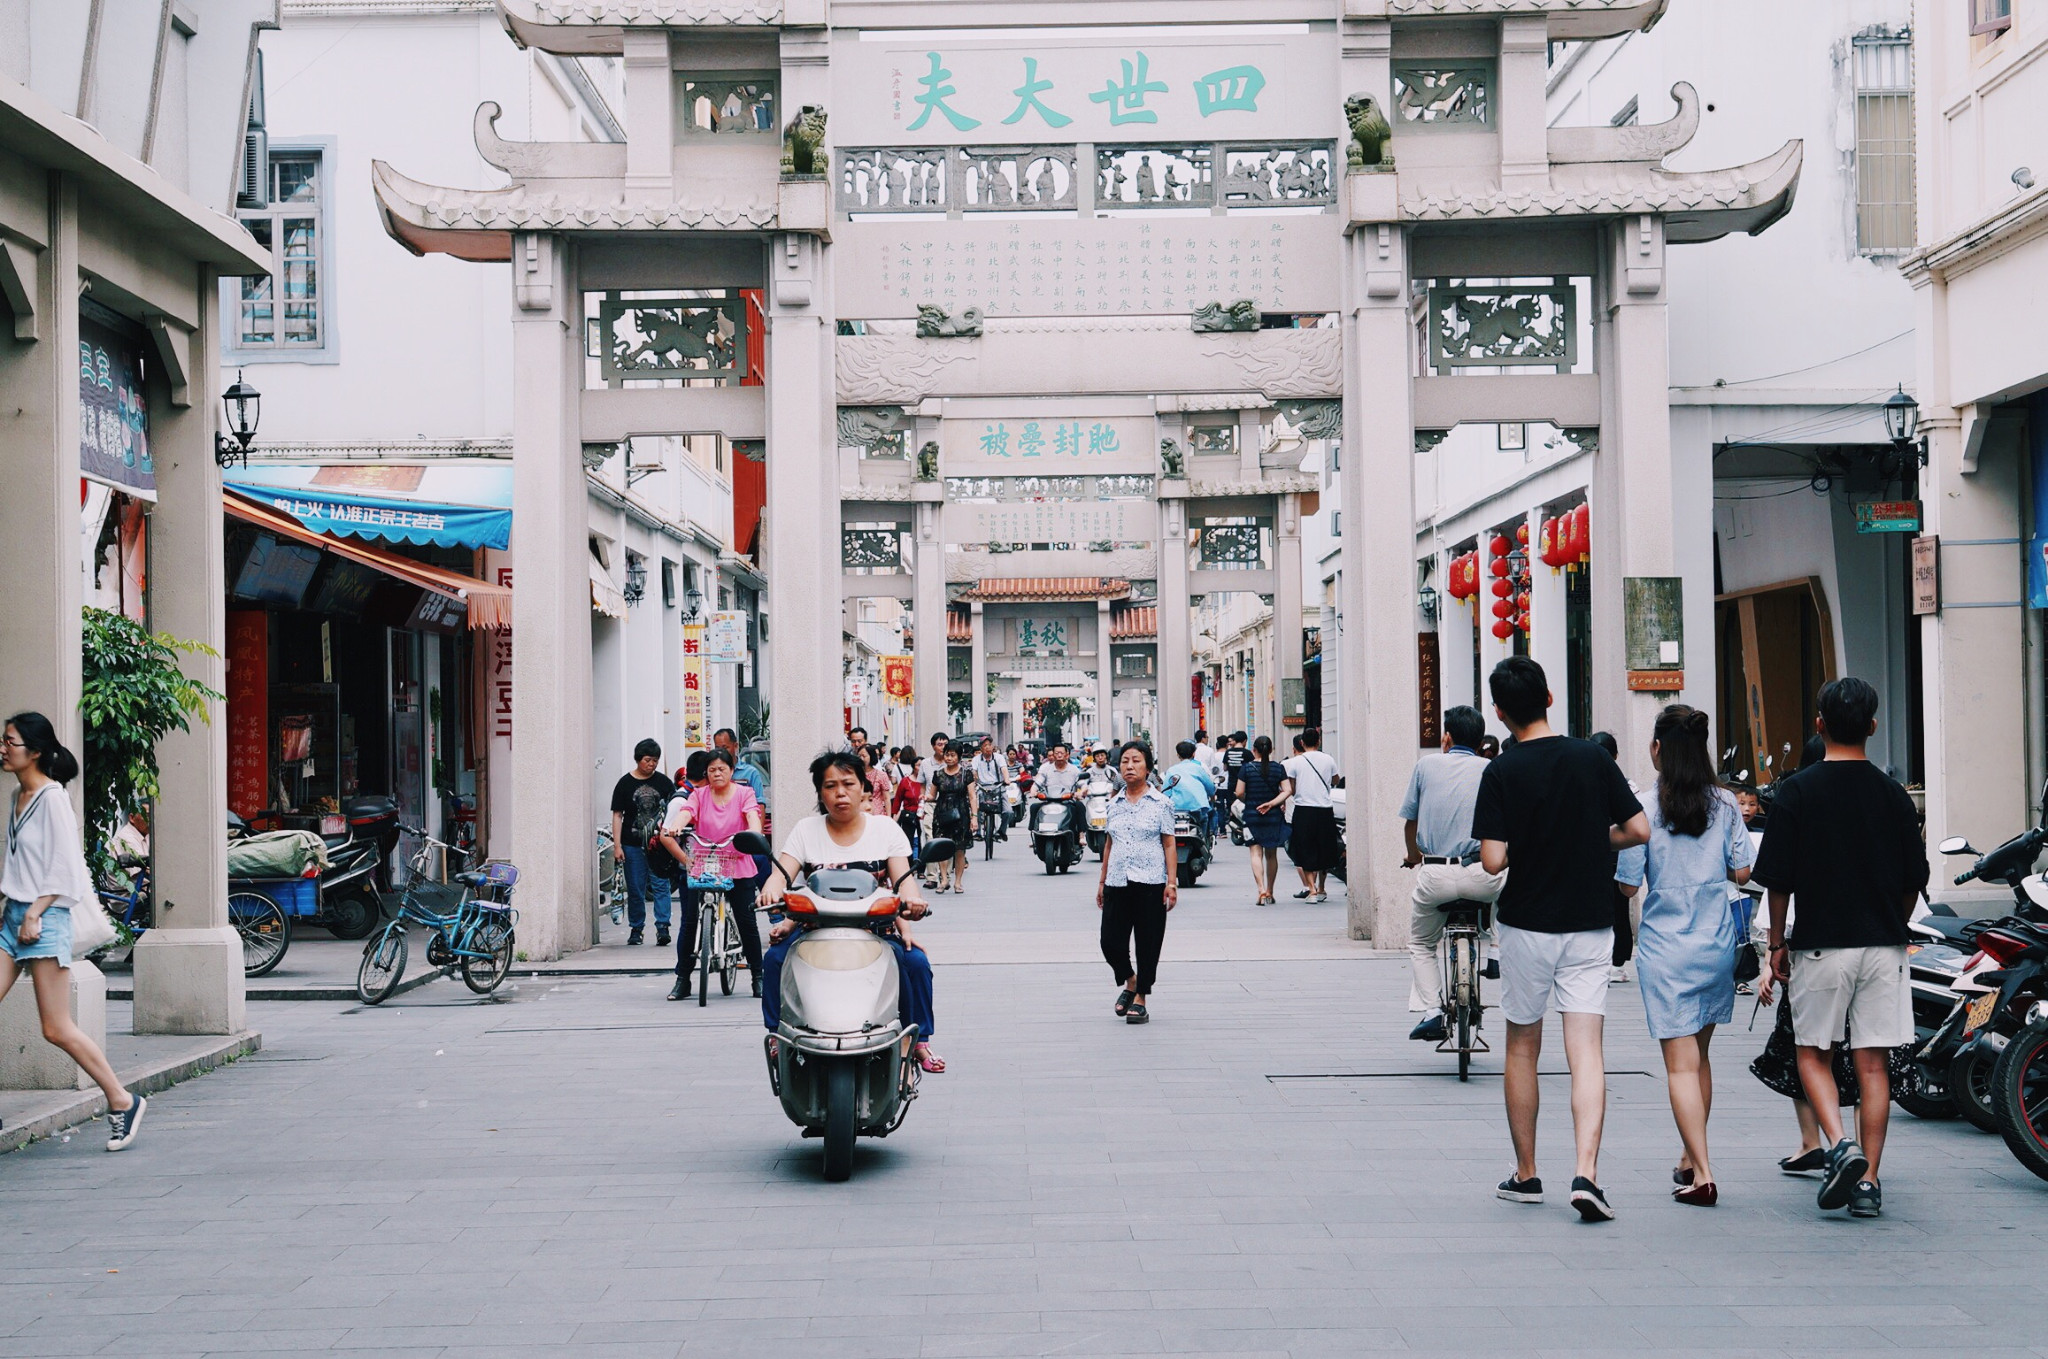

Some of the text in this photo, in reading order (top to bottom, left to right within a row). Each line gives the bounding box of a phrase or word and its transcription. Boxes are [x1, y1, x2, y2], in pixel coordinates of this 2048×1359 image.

[907, 51, 1266, 132] 四世大夫
[329, 503, 446, 531] 认准正宗王老吉
